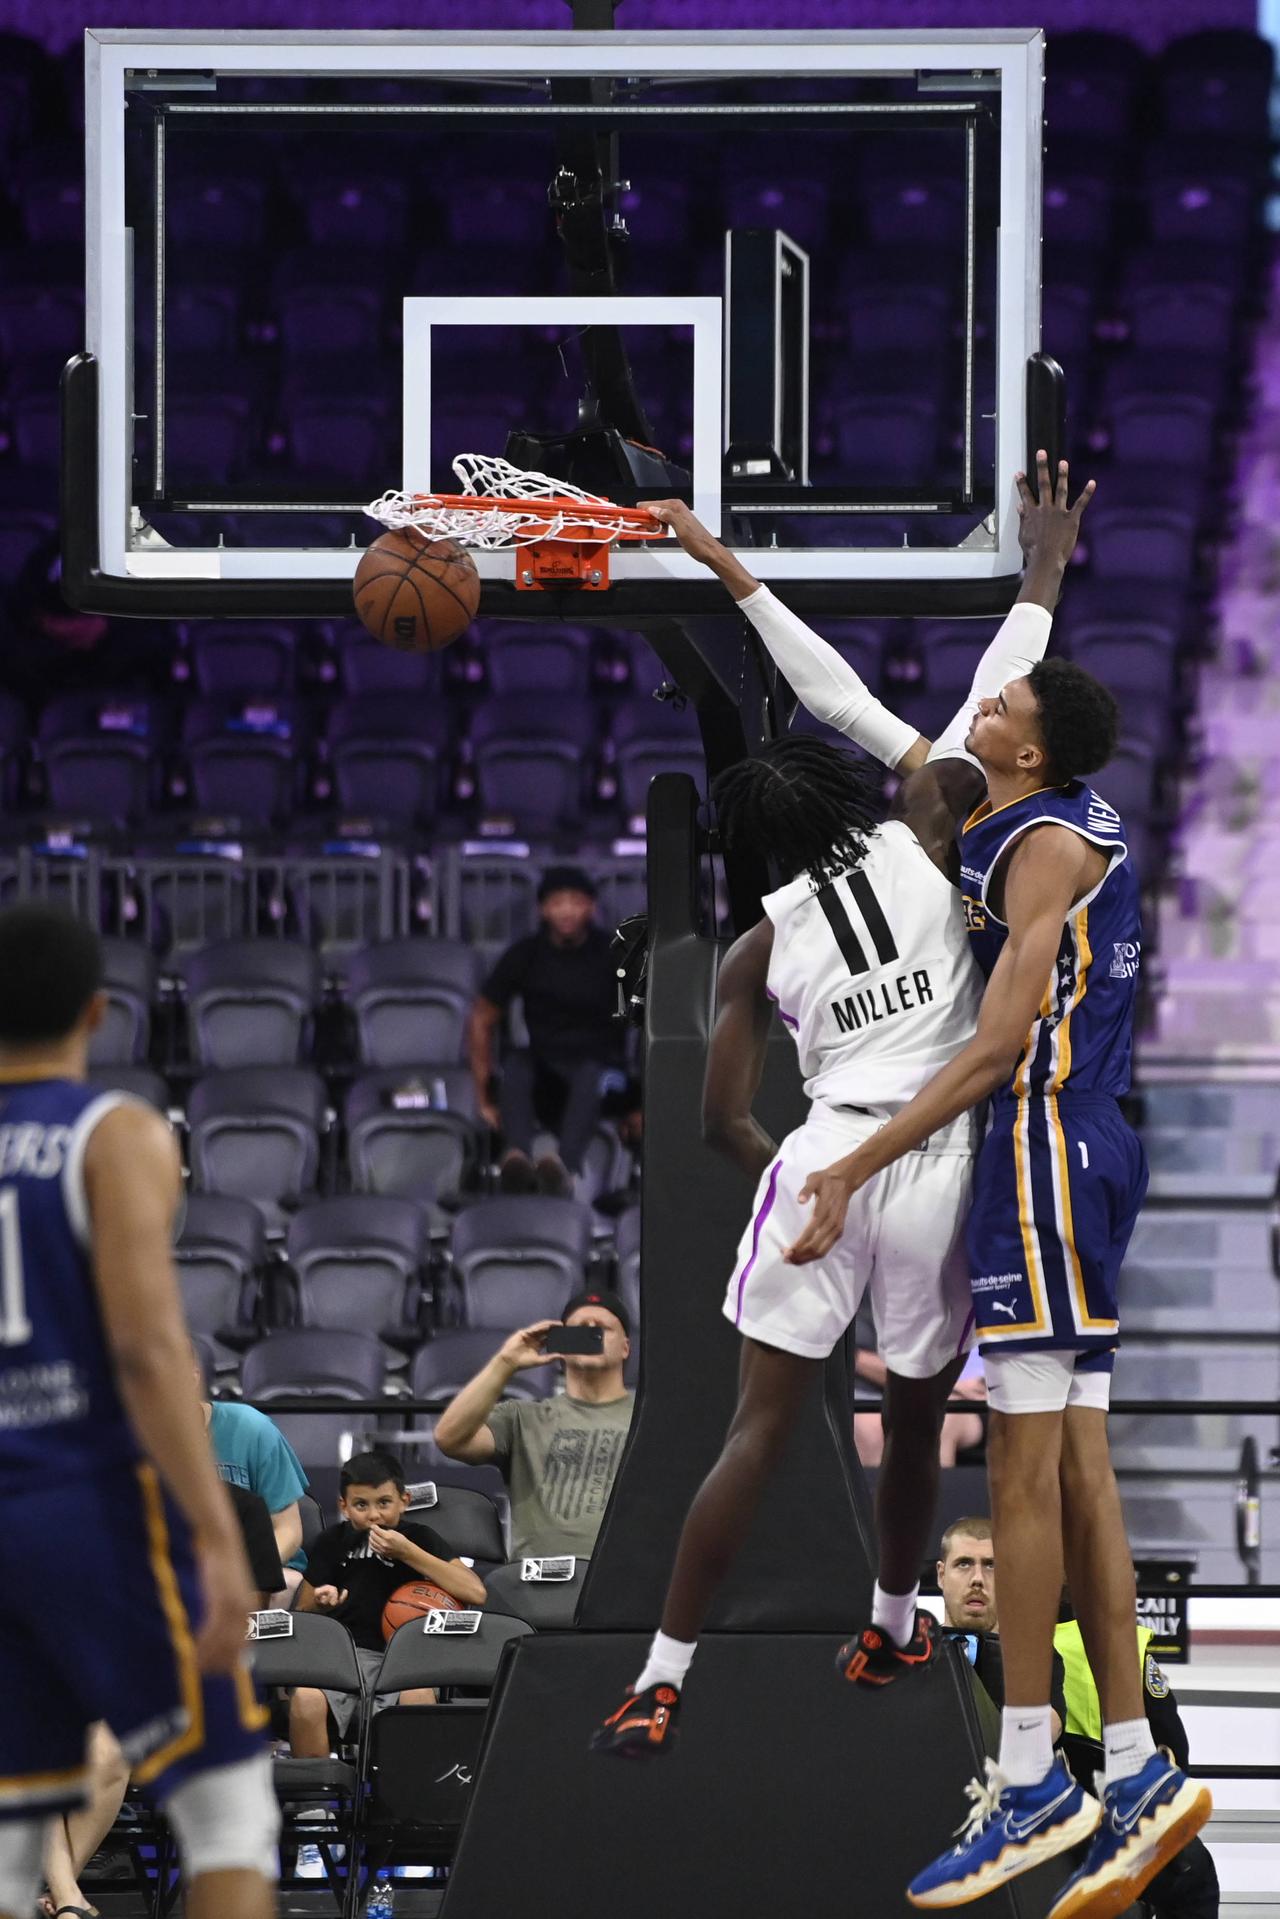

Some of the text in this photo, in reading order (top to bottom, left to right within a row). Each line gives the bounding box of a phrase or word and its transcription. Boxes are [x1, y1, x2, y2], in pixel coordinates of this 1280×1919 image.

[816, 869, 899, 976] 11
[831, 969, 933, 1033] MILLER
[1077, 1141, 1089, 1169] 1
